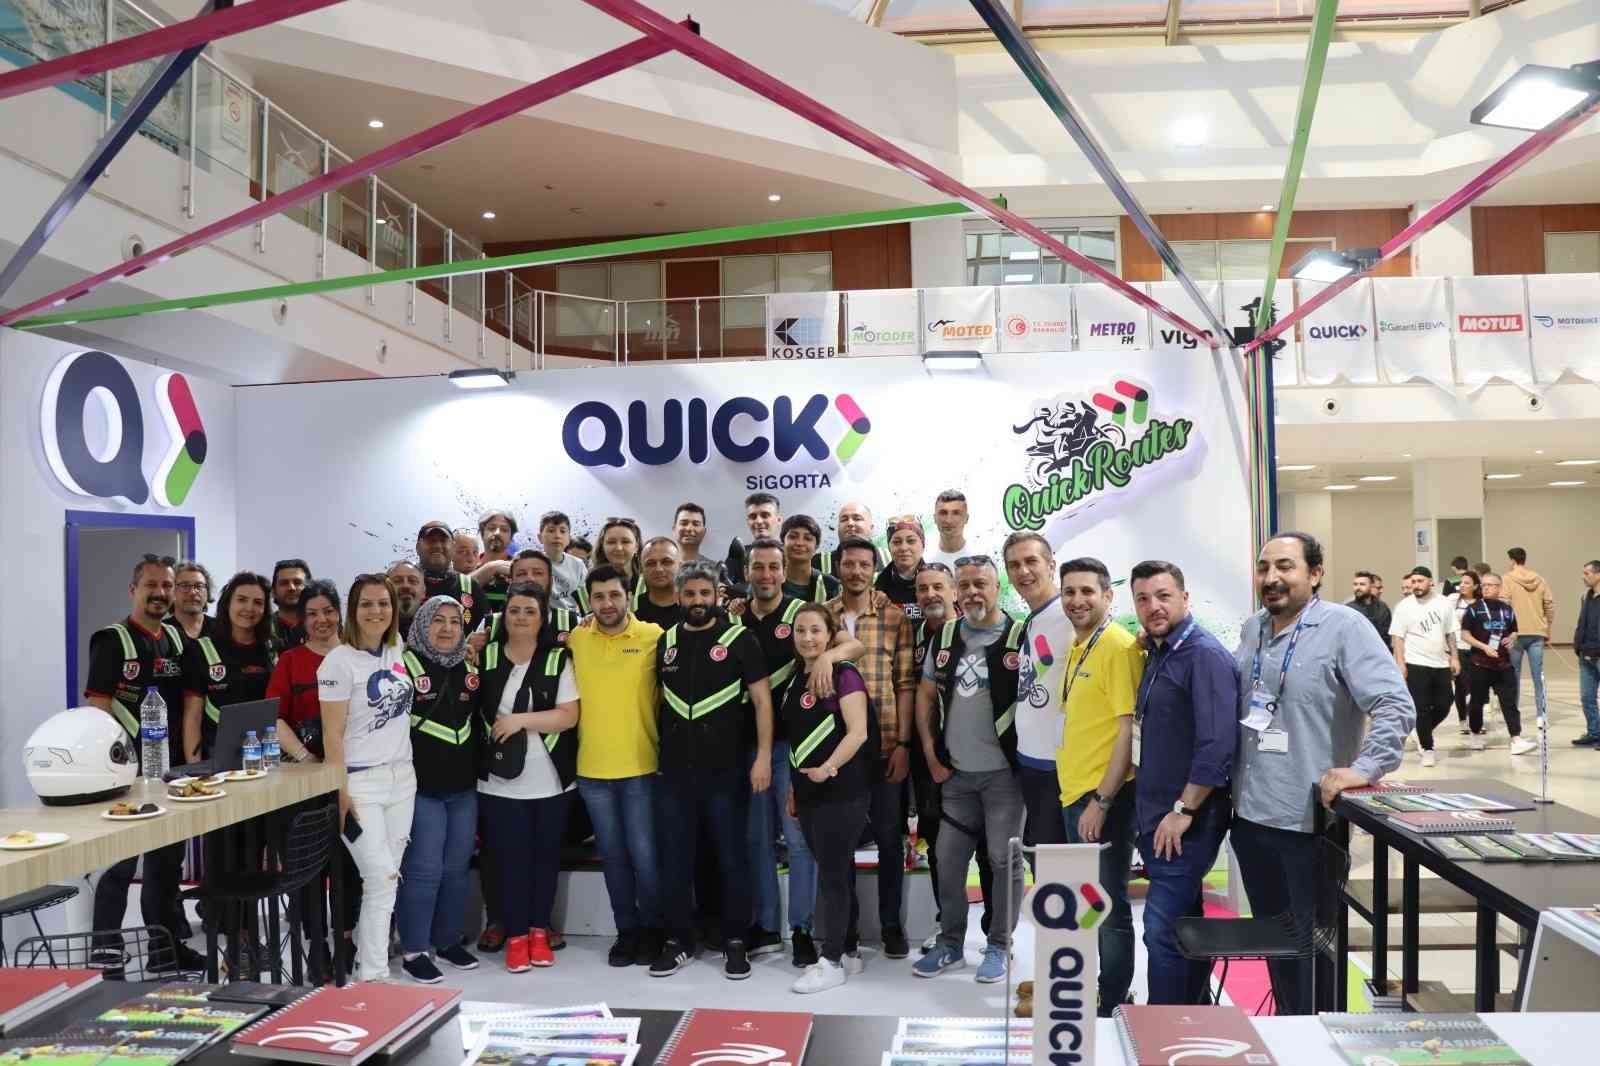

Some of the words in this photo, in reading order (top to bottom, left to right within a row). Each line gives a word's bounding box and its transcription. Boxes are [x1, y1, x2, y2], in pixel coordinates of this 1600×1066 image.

[943, 323, 993, 337] MOTED
[1090, 321, 1136, 337] METRO
[1462, 317, 1521, 331] MOTUL
[1309, 325, 1361, 339] QUICK
[1121, 335, 1135, 345] FM
[771, 346, 835, 360] KOSGEB
[562, 393, 831, 467] QUICK
[1002, 457, 1095, 531] Quick
[1085, 418, 1193, 490] Routes
[1032, 882, 1079, 931] Q
